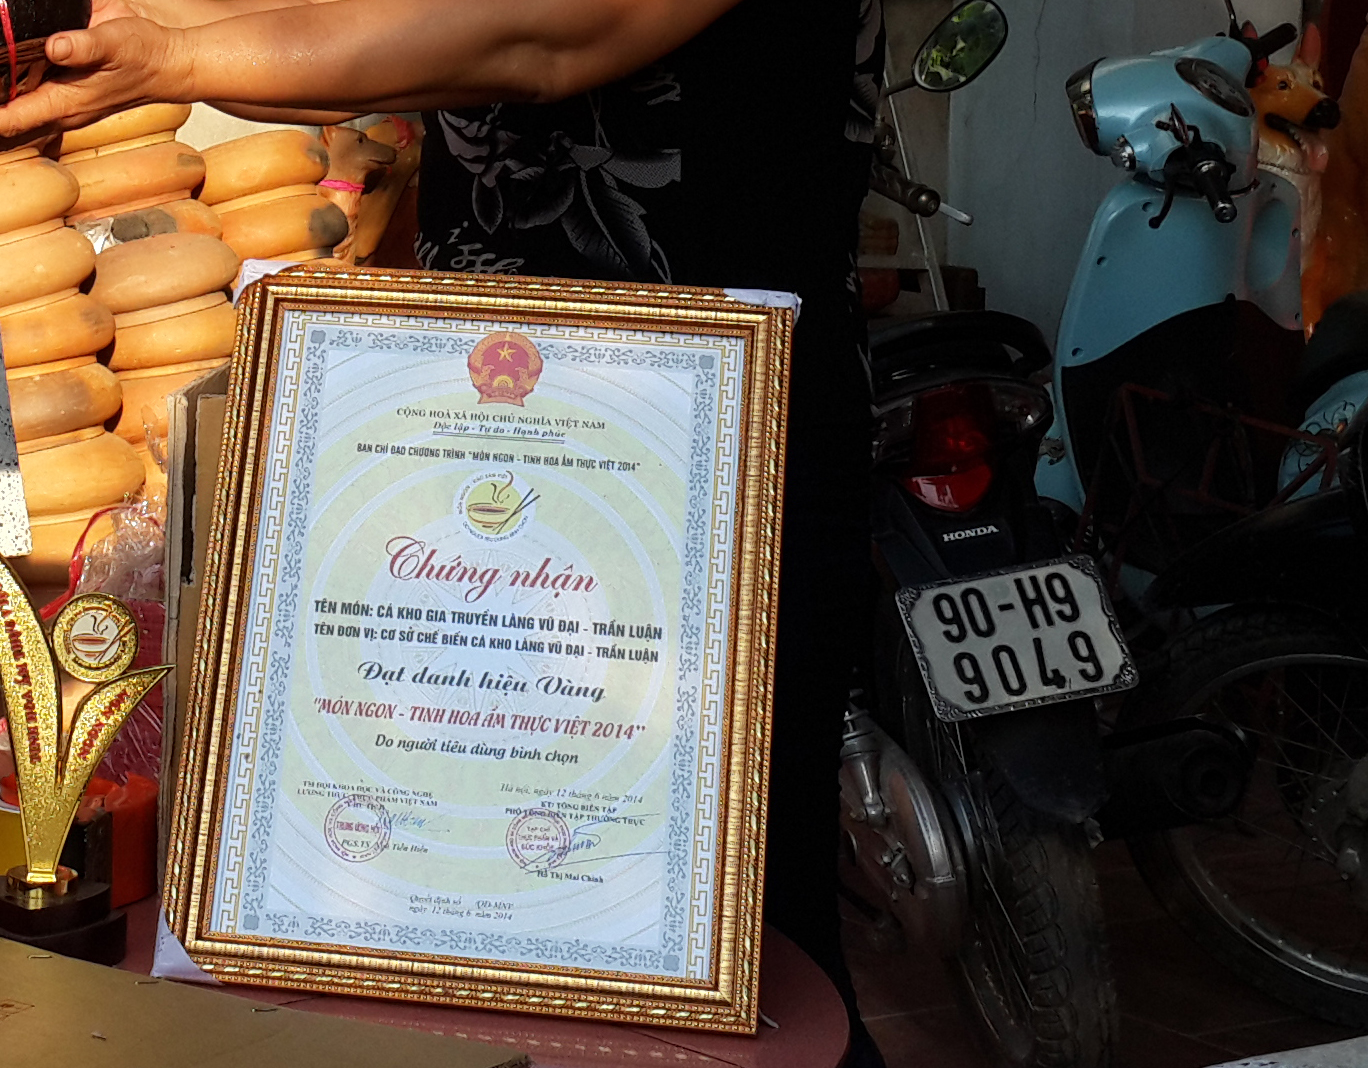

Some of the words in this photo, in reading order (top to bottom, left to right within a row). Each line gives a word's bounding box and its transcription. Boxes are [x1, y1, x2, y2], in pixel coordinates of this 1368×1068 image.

[397, 406, 426, 418] CỘNG
[470, 411, 489, 422] HỘI
[492, 413, 515, 423] CHỦ
[517, 415, 552, 426] NGHĨA
[554, 417, 579, 429] VIỆT
[581, 420, 606, 430] NAM
[357, 443, 372, 453] BAN
[942, 524, 999, 542] HONDA
[385, 536, 502, 603] Chứng
[508, 557, 598, 599] nhận
[314, 599, 337, 614] TÊN
[341, 600, 373, 617] MÓN:
[376, 603, 393, 619] CÁ
[397, 606, 422, 621] KHO
[425, 609, 447, 623] GIA
[451, 608, 498, 628] TRUYỀN
[502, 613, 535, 630] LÀNG
[538, 616, 554, 632] VŨ
[558, 619, 580, 636] ĐẠI
[629, 623, 663, 643] LUẬN
[932, 572, 1081, 644] 90-H9
[314, 622, 335, 636] TÊN
[337, 625, 361, 638] ĐƠN
[364, 627, 378, 642] VỊ:
[380, 628, 397, 641] CƠ
[398, 626, 415, 643] SỞ
[416, 629, 440, 644] CHẾ
[441, 630, 468, 647] BIẾN
[471, 634, 486, 648] CÁ
[488, 637, 512, 651] KHO
[515, 637, 545, 653] LÀNG
[548, 640, 563, 655] VŨ
[565, 643, 585, 659] ĐẠI
[628, 647, 659, 665] LUẬN
[357, 661, 406, 685] Đạt
[411, 666, 472, 688] danh
[478, 671, 529, 696] hiệu
[536, 675, 607, 703] Vàng
[953, 630, 1104, 704] 9049
[354, 701, 398, 720] NGON
[409, 705, 446, 724] TINH
[447, 709, 481, 727] HOA
[481, 705, 506, 729] ẨM
[510, 714, 552, 736] THỰC
[553, 715, 591, 740] VIỆT
[375, 734, 394, 748] Do
[397, 737, 438, 752] người
[441, 740, 467, 754] tiêu
[470, 743, 506, 760] dùng
[510, 746, 541, 761] bình
[545, 749, 579, 765] chọn
